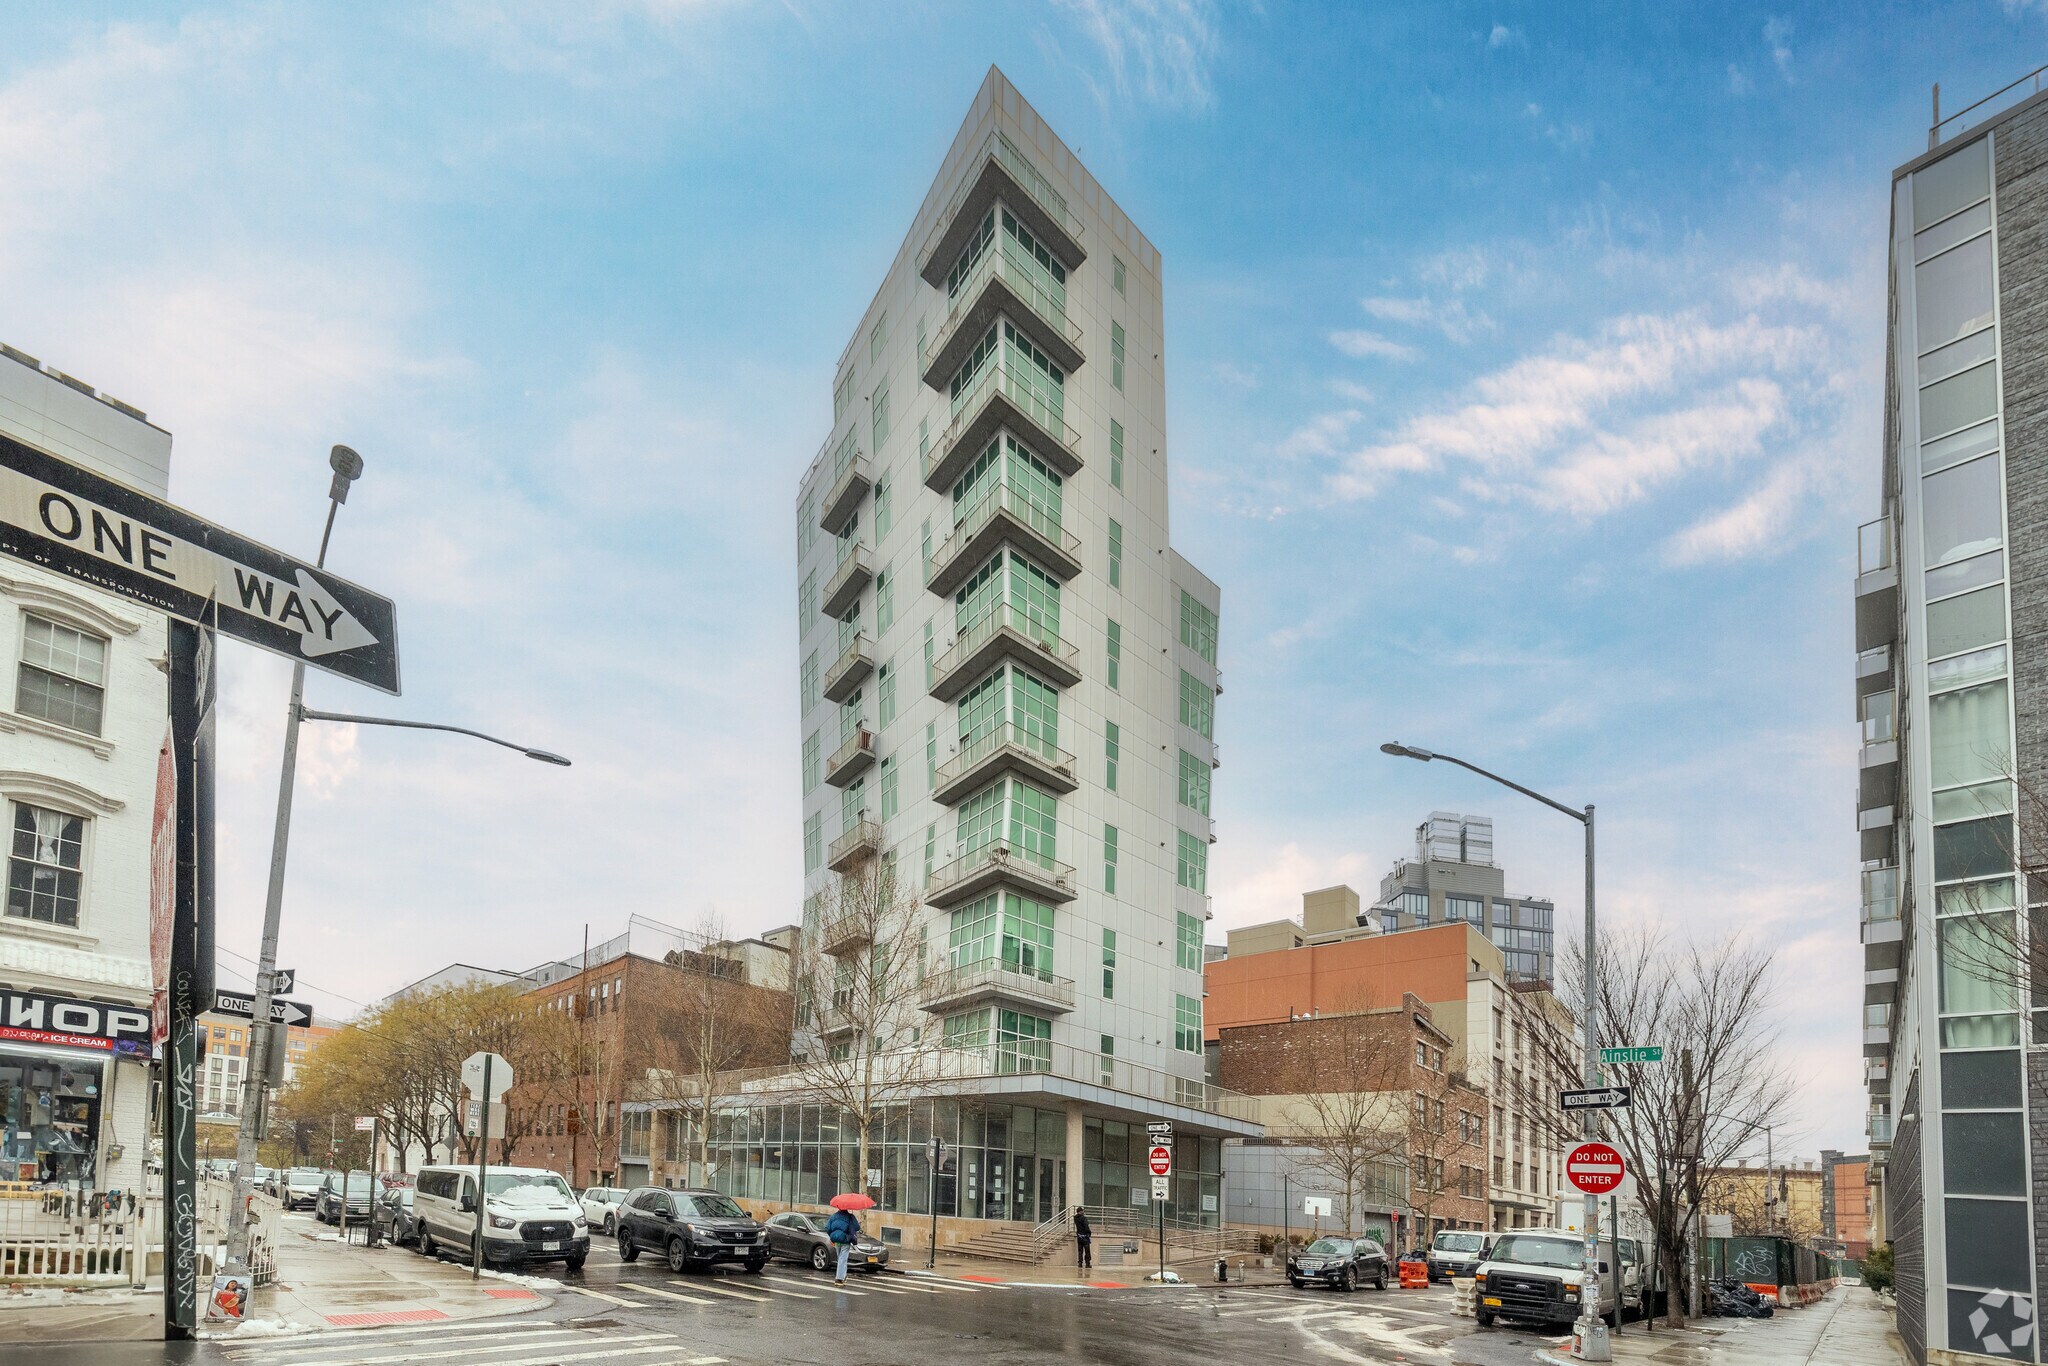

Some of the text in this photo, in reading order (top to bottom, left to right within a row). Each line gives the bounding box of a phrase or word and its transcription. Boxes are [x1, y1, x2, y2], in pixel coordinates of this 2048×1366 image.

[38, 492, 344, 641] ONE WAY
[35, 553, 51, 564] OF
[66, 565, 175, 609] TRANSPORTATION
[222, 998, 286, 1017] ONE AY
[50, 1034, 68, 1043] ICE
[69, 1037, 107, 1047] CREAM
[1600, 1048, 1660, 1062] Ainslie St
[1569, 1093, 1620, 1105] ONE WAY
[1576, 1153, 1614, 1162] DO NOT
[1578, 1175, 1612, 1184] ENTER
